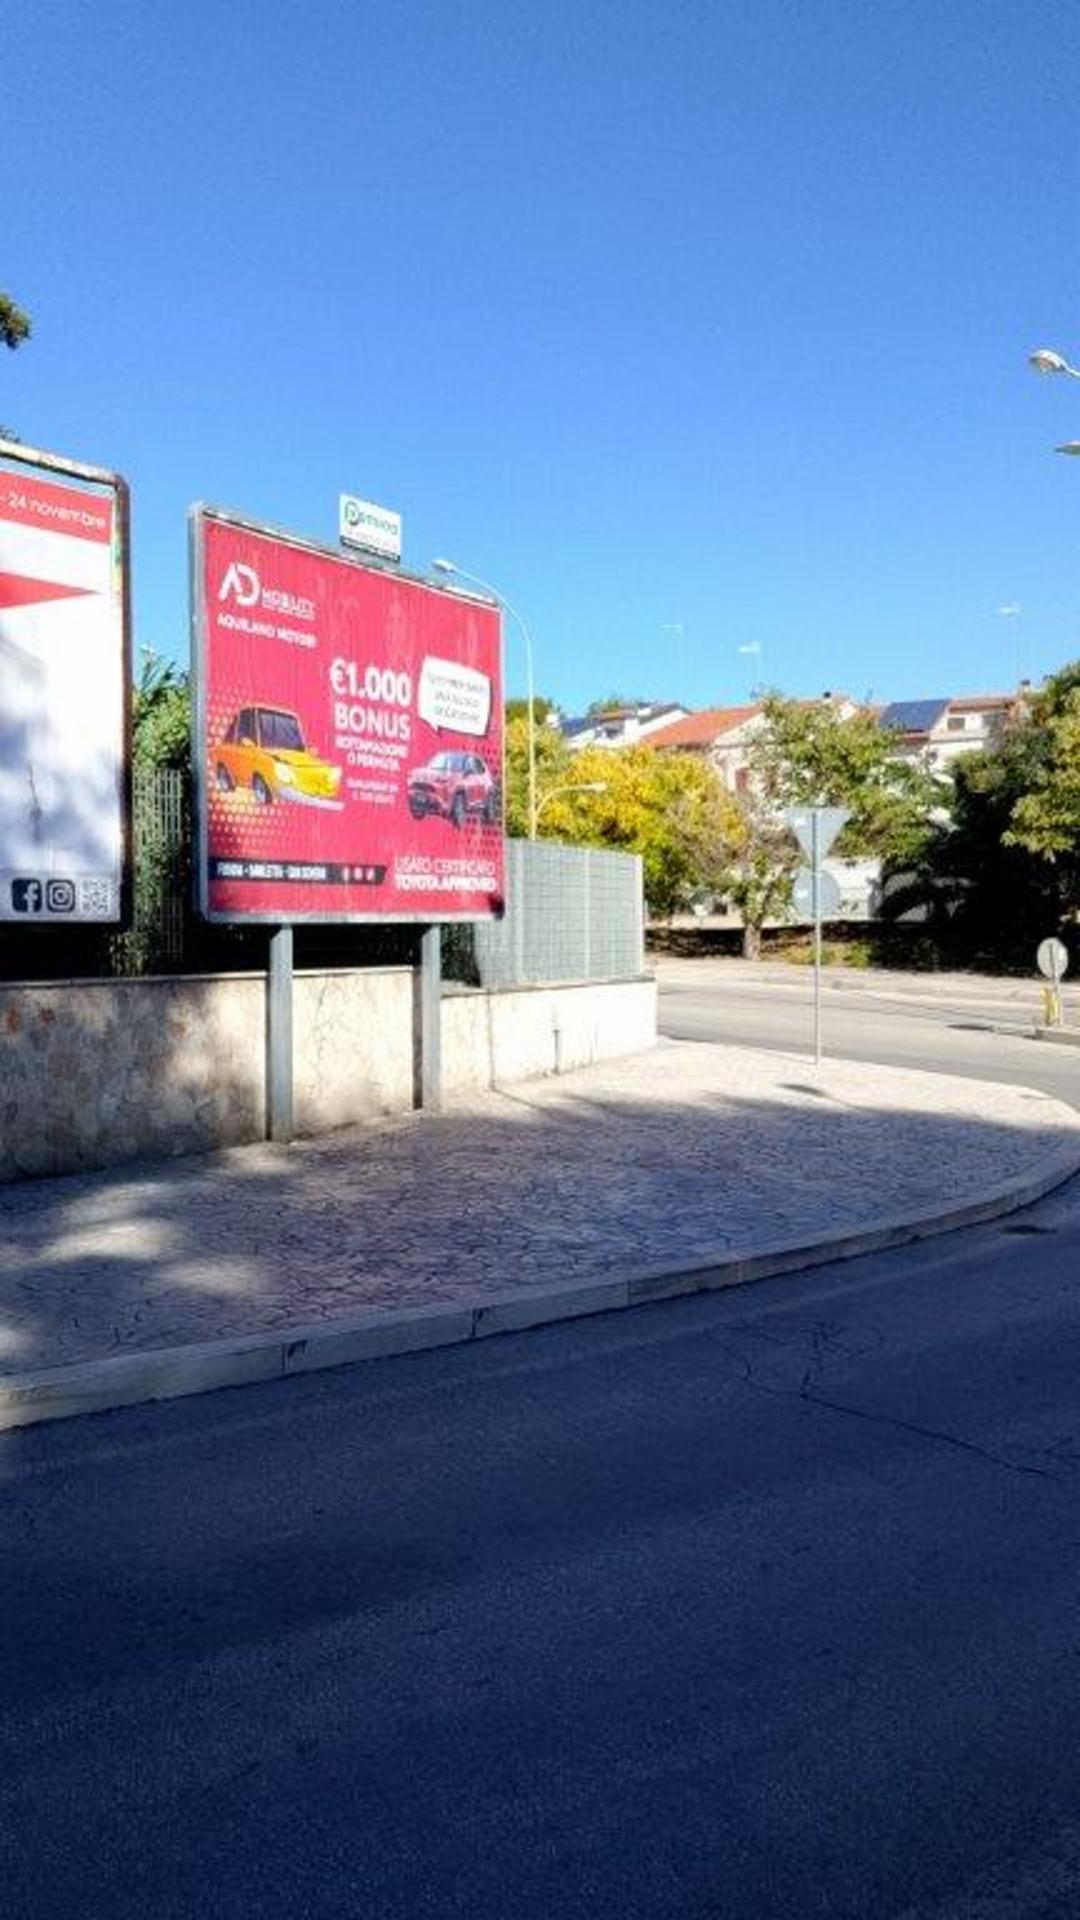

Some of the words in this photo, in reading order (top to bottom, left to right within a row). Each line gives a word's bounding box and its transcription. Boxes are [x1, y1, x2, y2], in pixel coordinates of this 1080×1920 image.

[9, 488, 27, 509] 24
[29, 498, 106, 528] novembre
[330, 658, 412, 707] €1.000
[335, 701, 411, 741] BONUS
[395, 856, 432, 873] USATO
